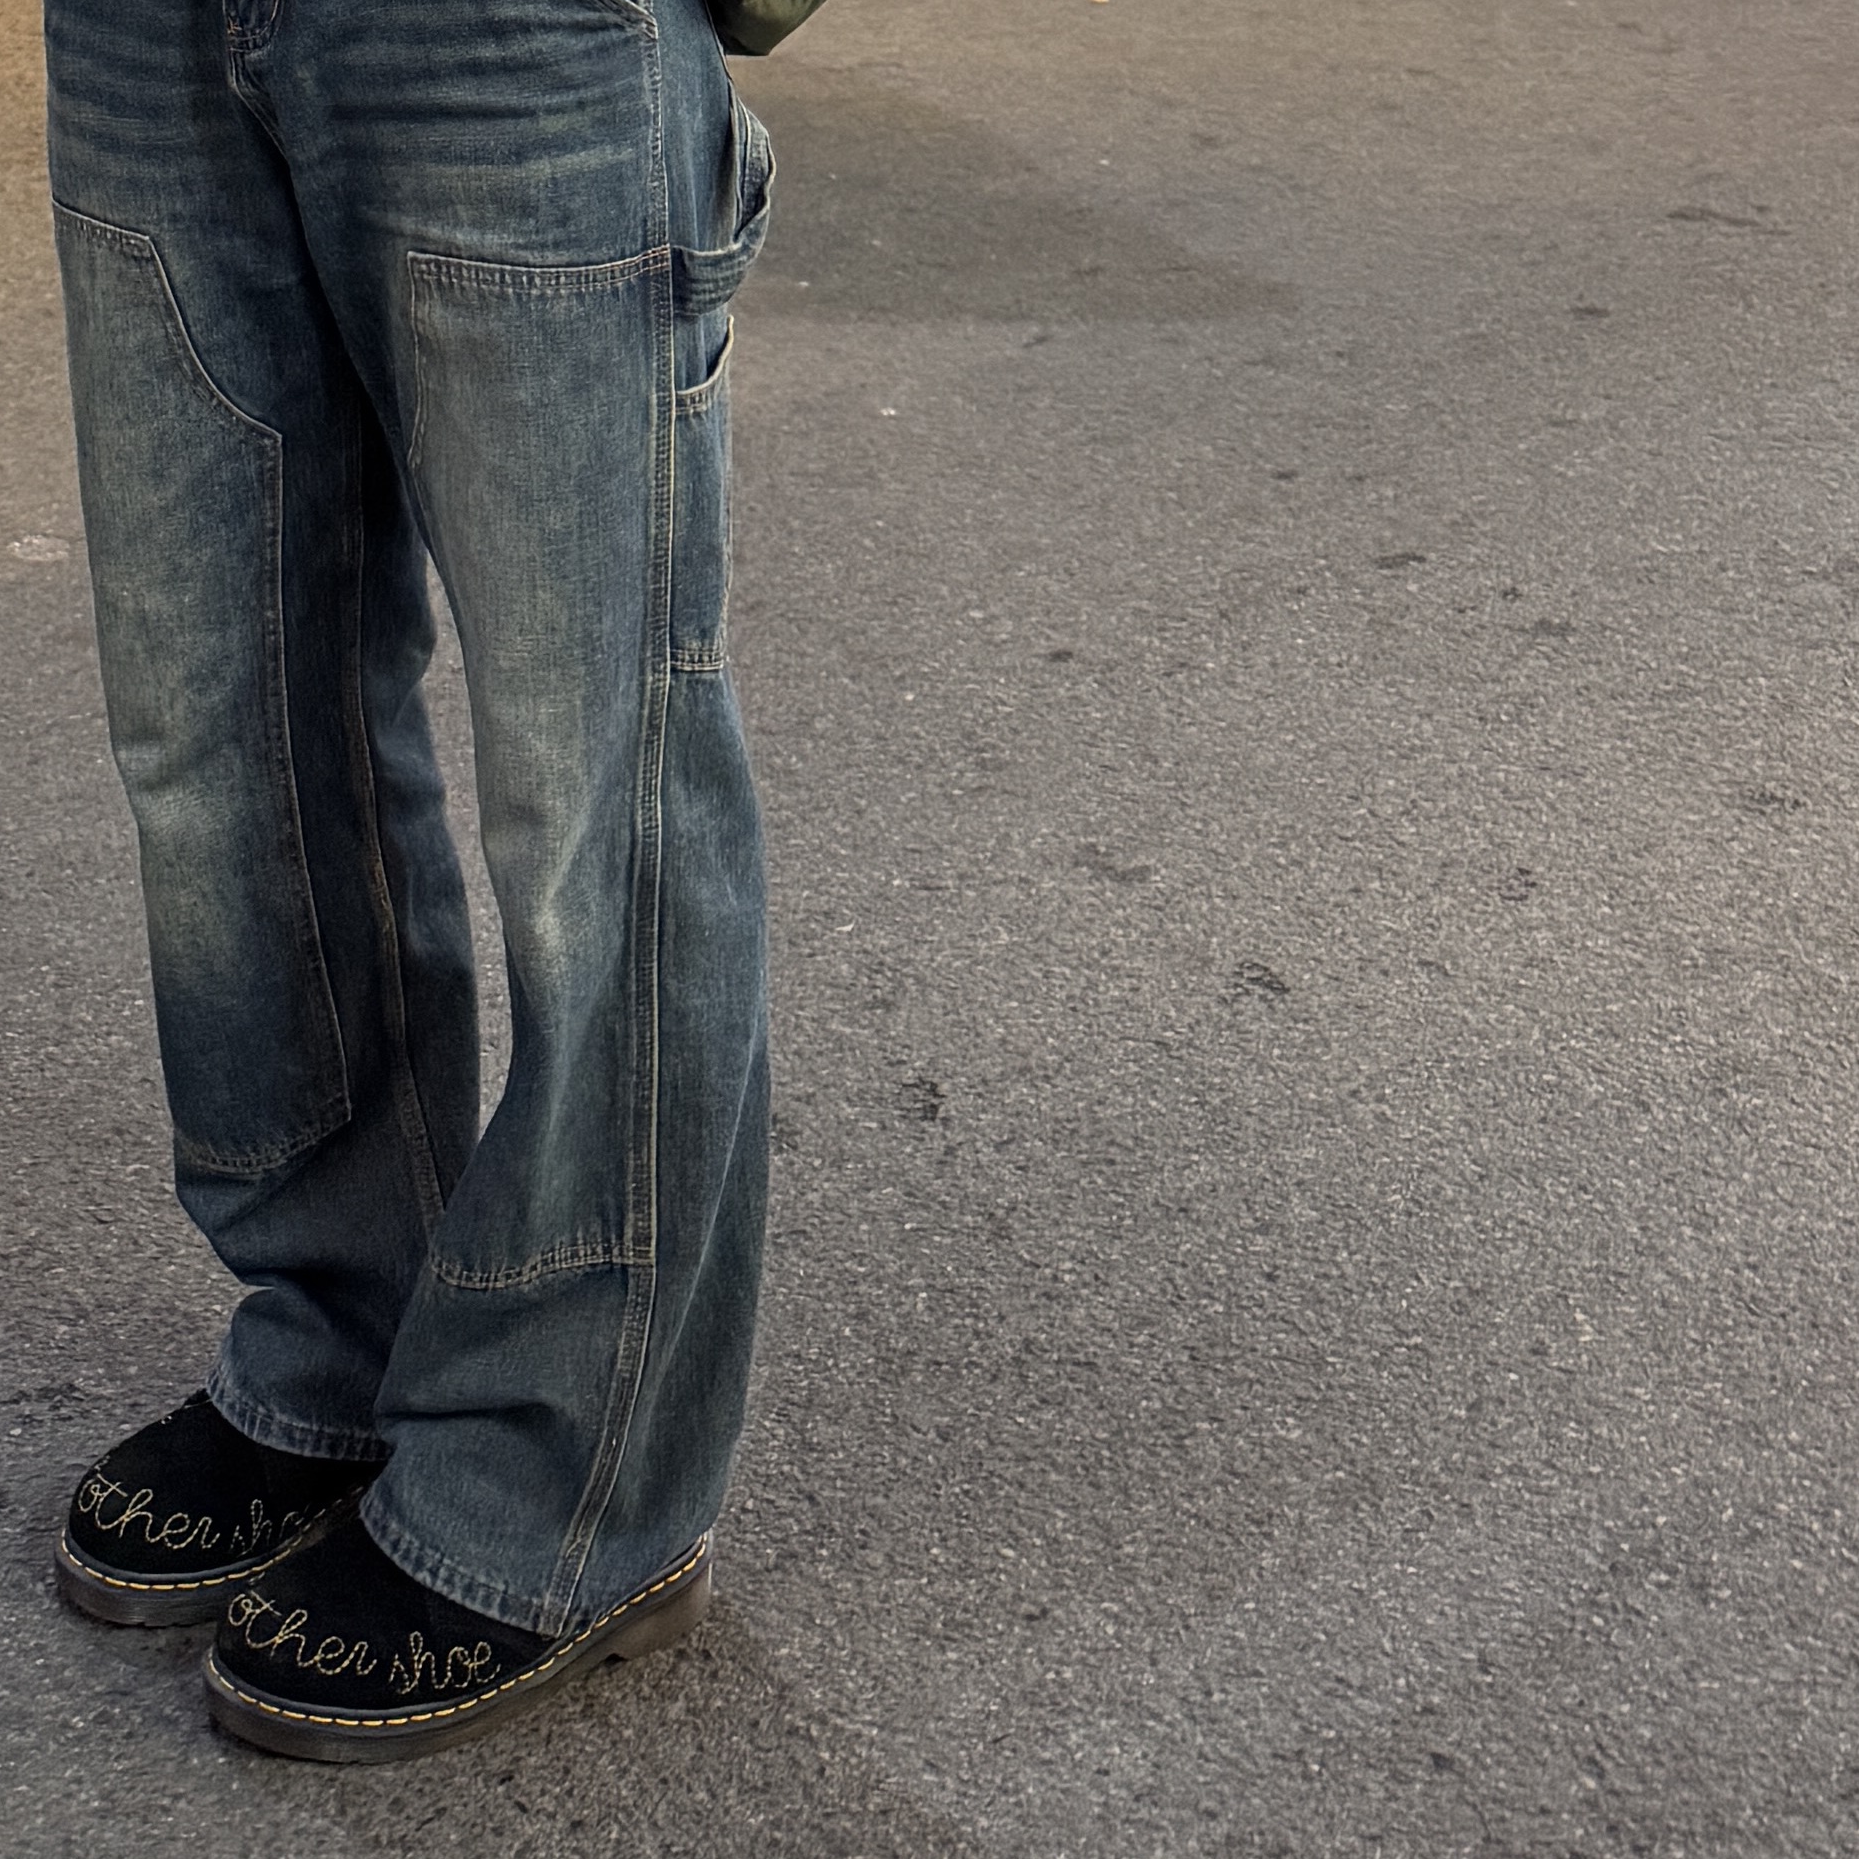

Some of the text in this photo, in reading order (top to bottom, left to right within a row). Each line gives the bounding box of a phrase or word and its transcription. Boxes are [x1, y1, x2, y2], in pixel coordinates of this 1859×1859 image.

[78, 1473, 220, 1550] other
[228, 1590, 502, 1694] other shoe
